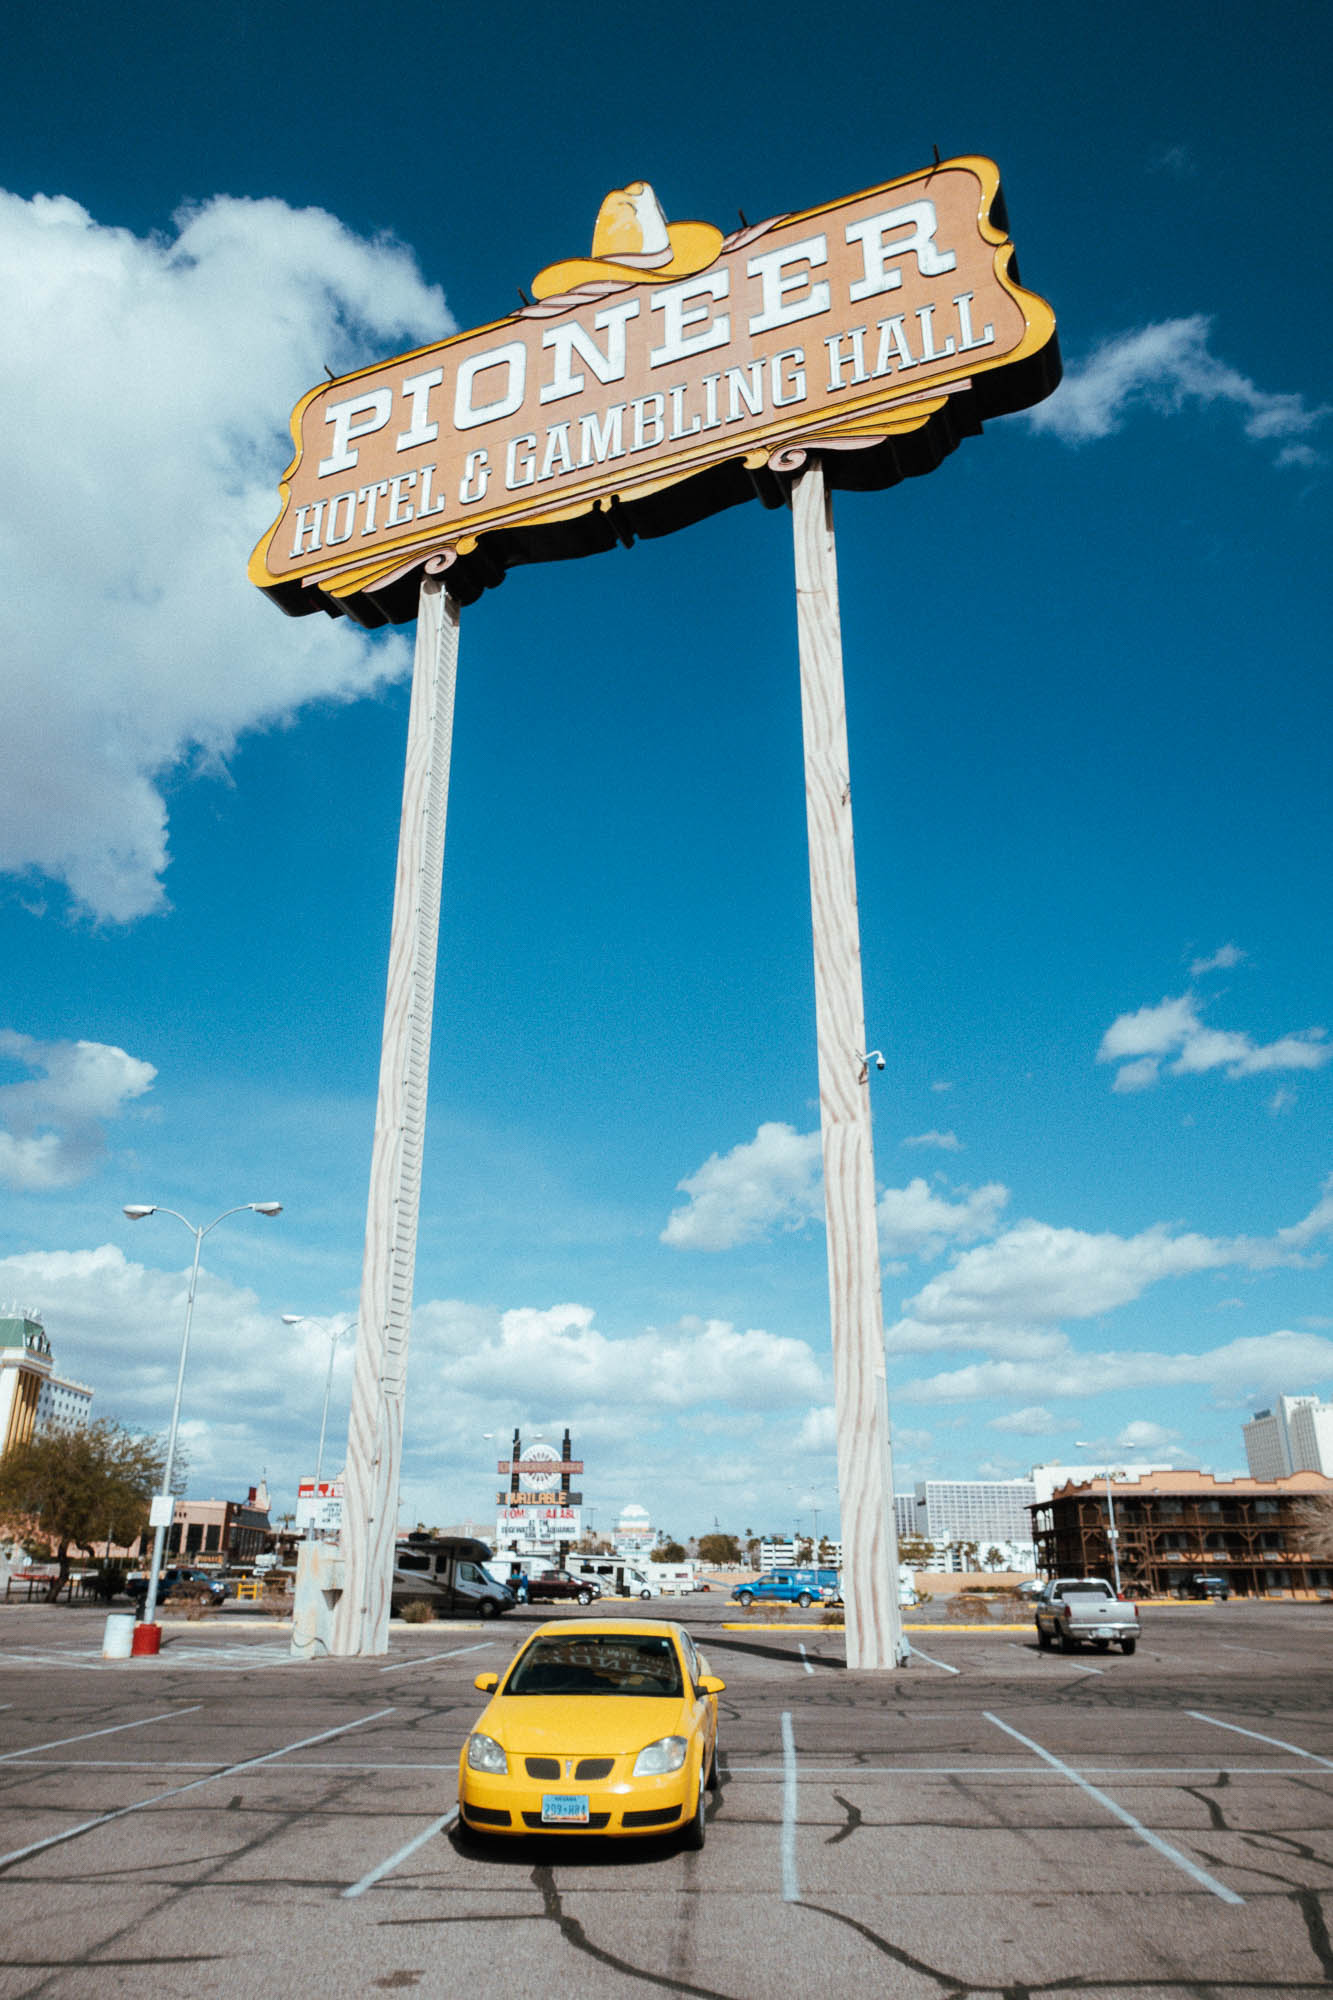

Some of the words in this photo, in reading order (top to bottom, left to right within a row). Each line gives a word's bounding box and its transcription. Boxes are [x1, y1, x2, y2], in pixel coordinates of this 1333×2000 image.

[289, 463, 445, 559] HOTEL
[459, 448, 492, 505] &
[505, 347, 807, 490] GAMBLING
[824, 290, 995, 393] HALL
[318, 197, 957, 479] PIONEER
